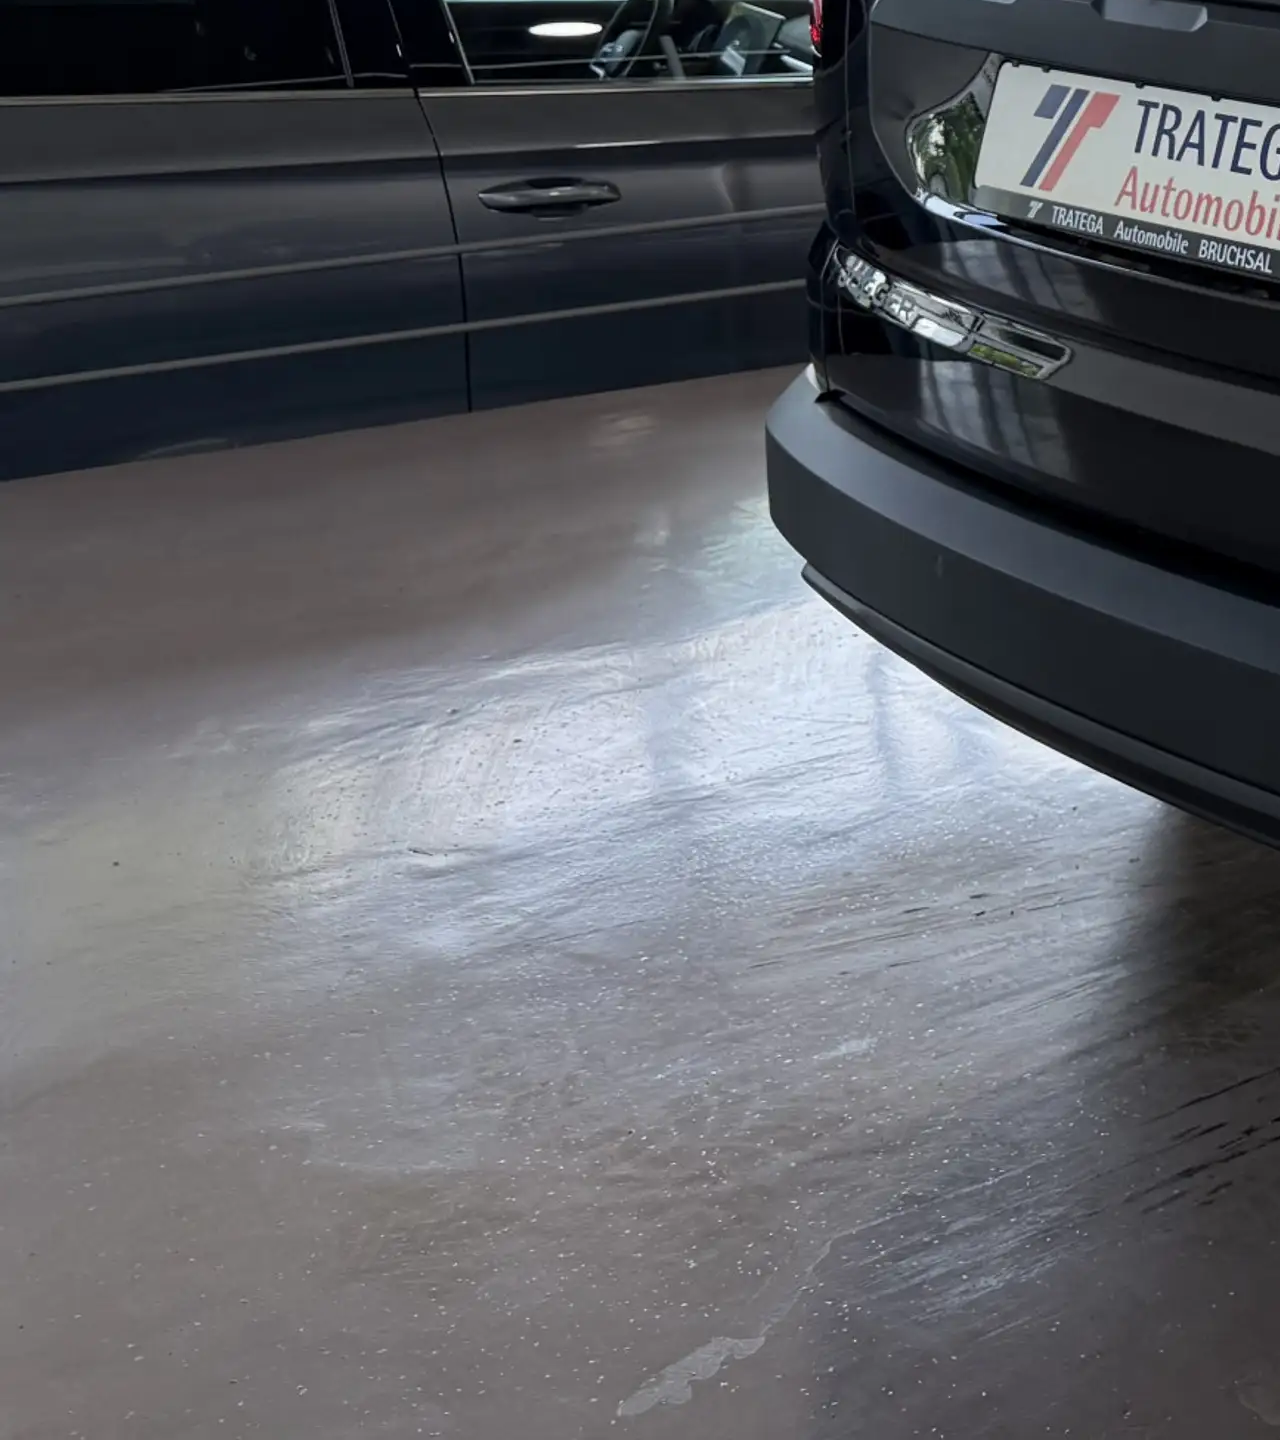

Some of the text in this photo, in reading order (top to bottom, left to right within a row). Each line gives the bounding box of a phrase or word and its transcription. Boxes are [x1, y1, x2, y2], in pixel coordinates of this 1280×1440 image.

[1051, 205, 1273, 274] TRATEGA Automobile BRUCHSAL
